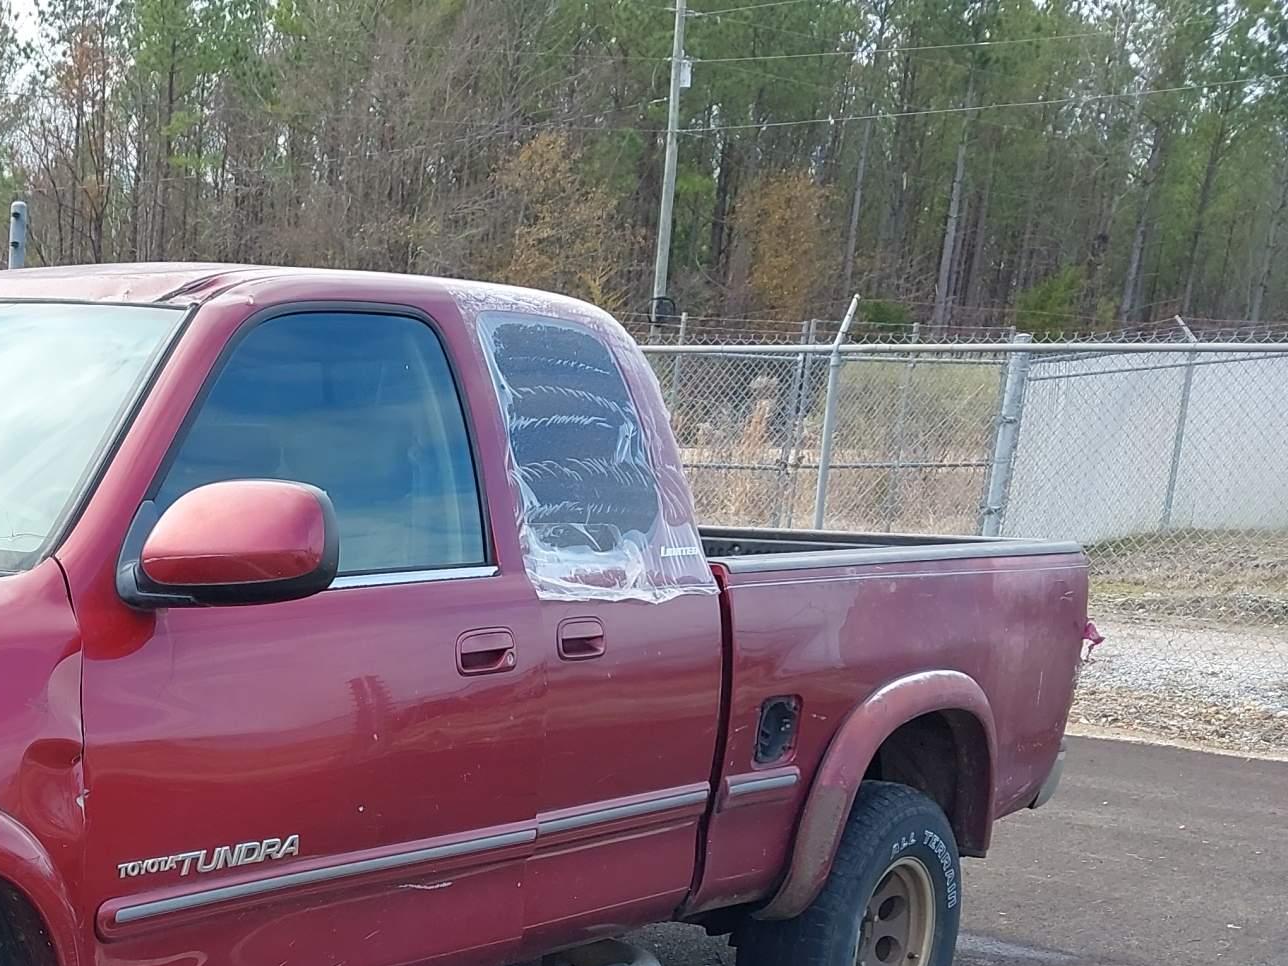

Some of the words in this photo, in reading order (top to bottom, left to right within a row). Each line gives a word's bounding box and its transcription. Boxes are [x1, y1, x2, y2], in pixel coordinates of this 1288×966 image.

[117, 855, 178, 879] TOYOTA
[176, 834, 300, 877] TUNDRA
[889, 831, 917, 861] ALL
[922, 829, 957, 909] TERRAIN
